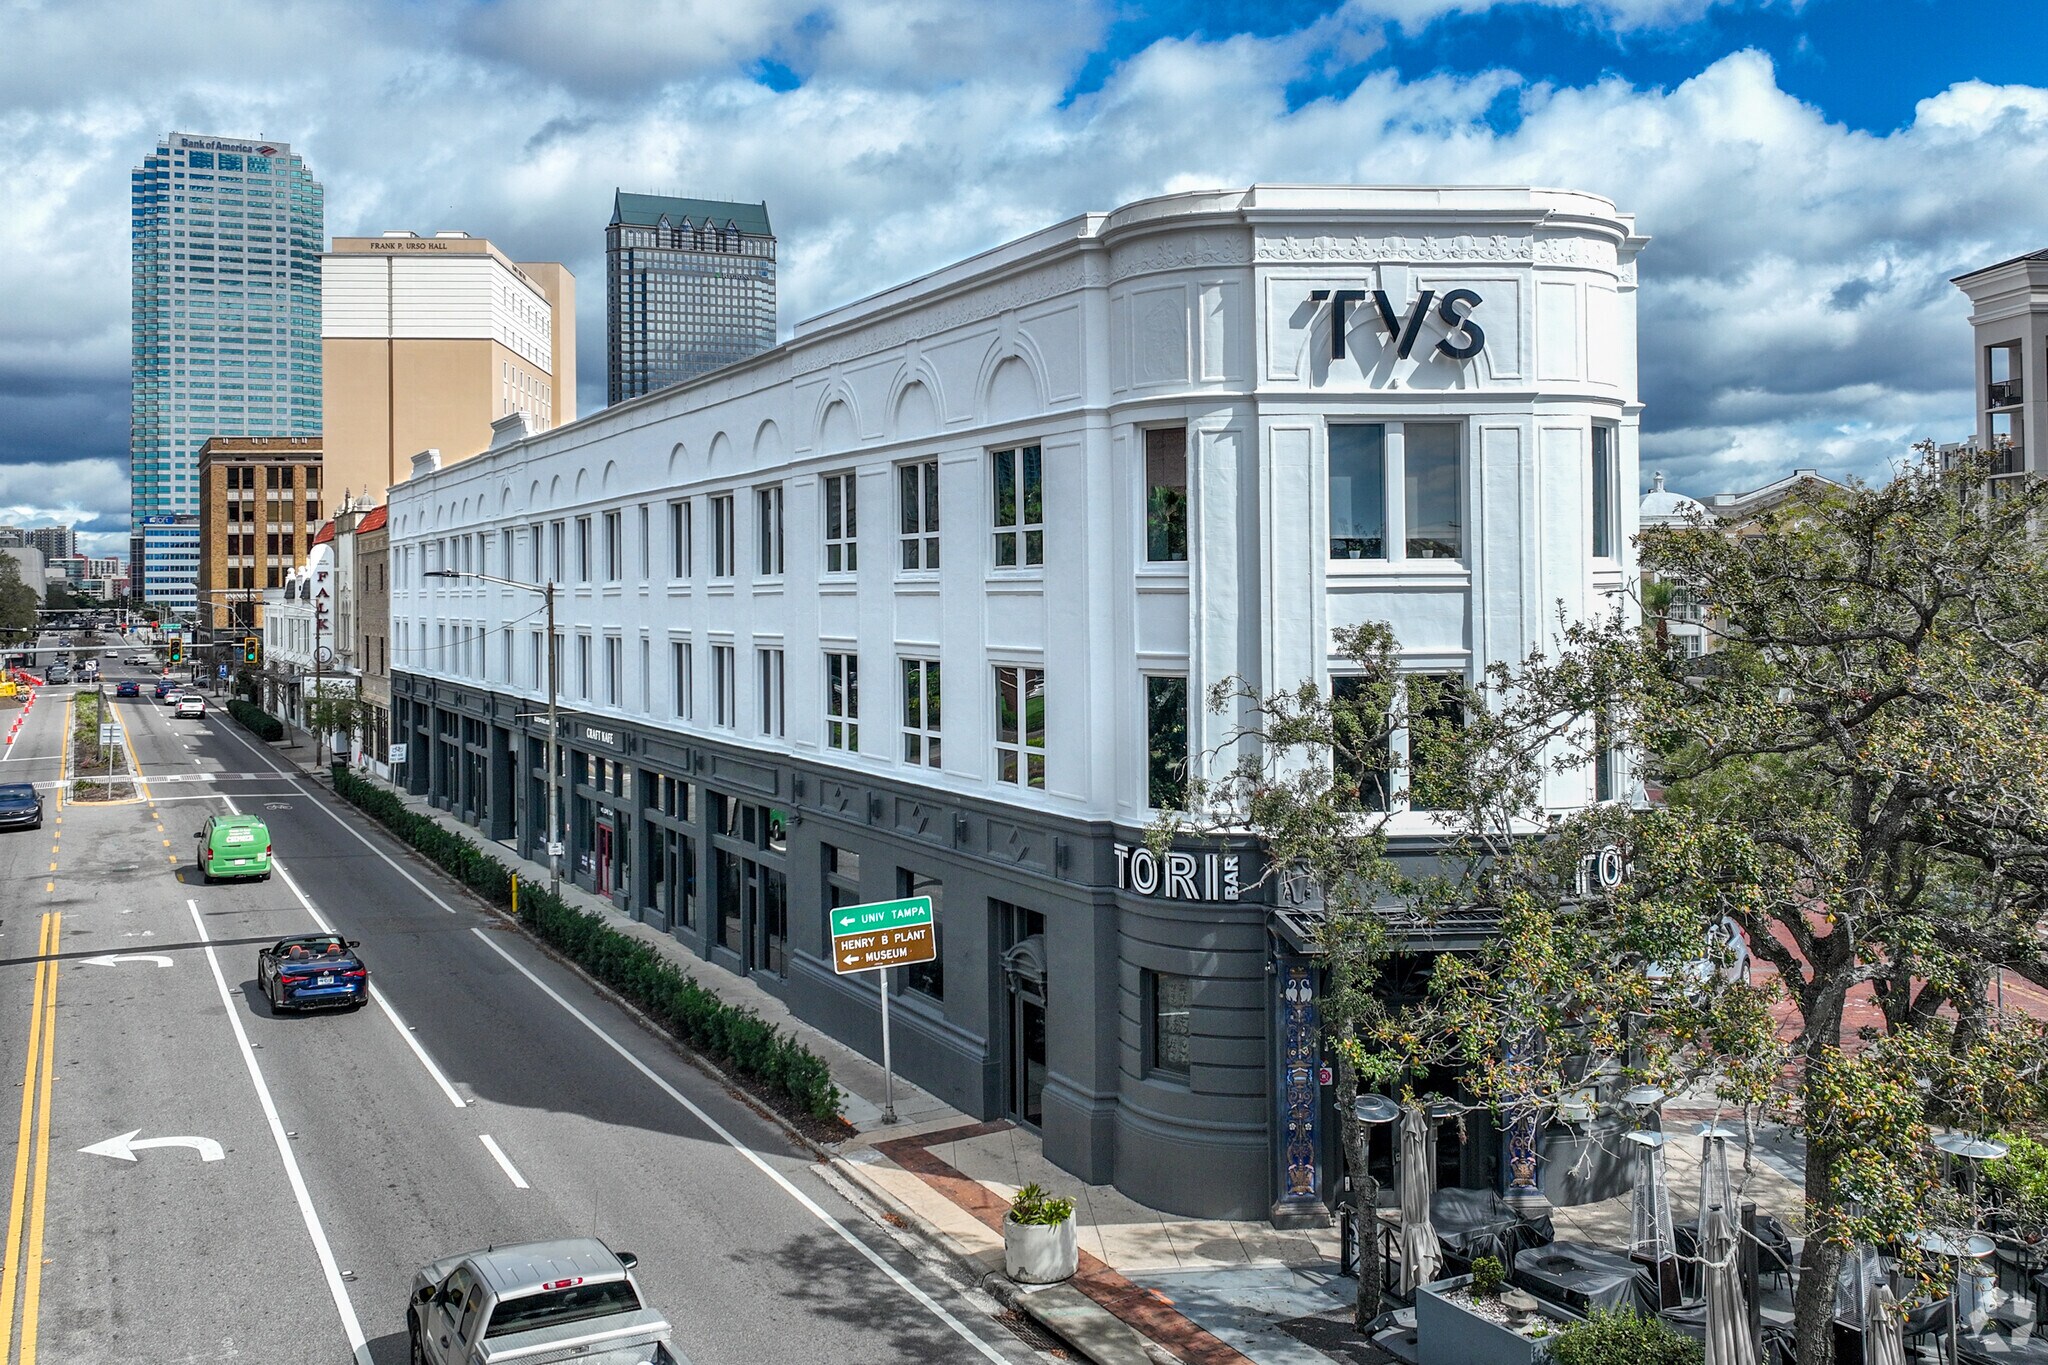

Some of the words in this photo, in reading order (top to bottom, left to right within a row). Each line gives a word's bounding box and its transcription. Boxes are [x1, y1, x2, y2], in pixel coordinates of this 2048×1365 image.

[181, 138, 206, 148] Bank
[206, 141, 215, 150] of
[215, 141, 253, 153] America
[370, 242, 396, 250] FRANK
[1310, 288, 1486, 360] TVS
[316, 571, 330, 630] FALK
[586, 727, 601, 741] CRAFT
[1113, 843, 1219, 901] TORI
[1224, 855, 1239, 900] BAR
[1575, 844, 1635, 895] TO
[861, 911, 885, 924] UNIV
[891, 906, 926, 920] TAMPA
[841, 936, 875, 951] HENRY
[881, 935, 889, 945] B
[894, 929, 926, 943] PLANT
[865, 947, 908, 962] MUSEUM
